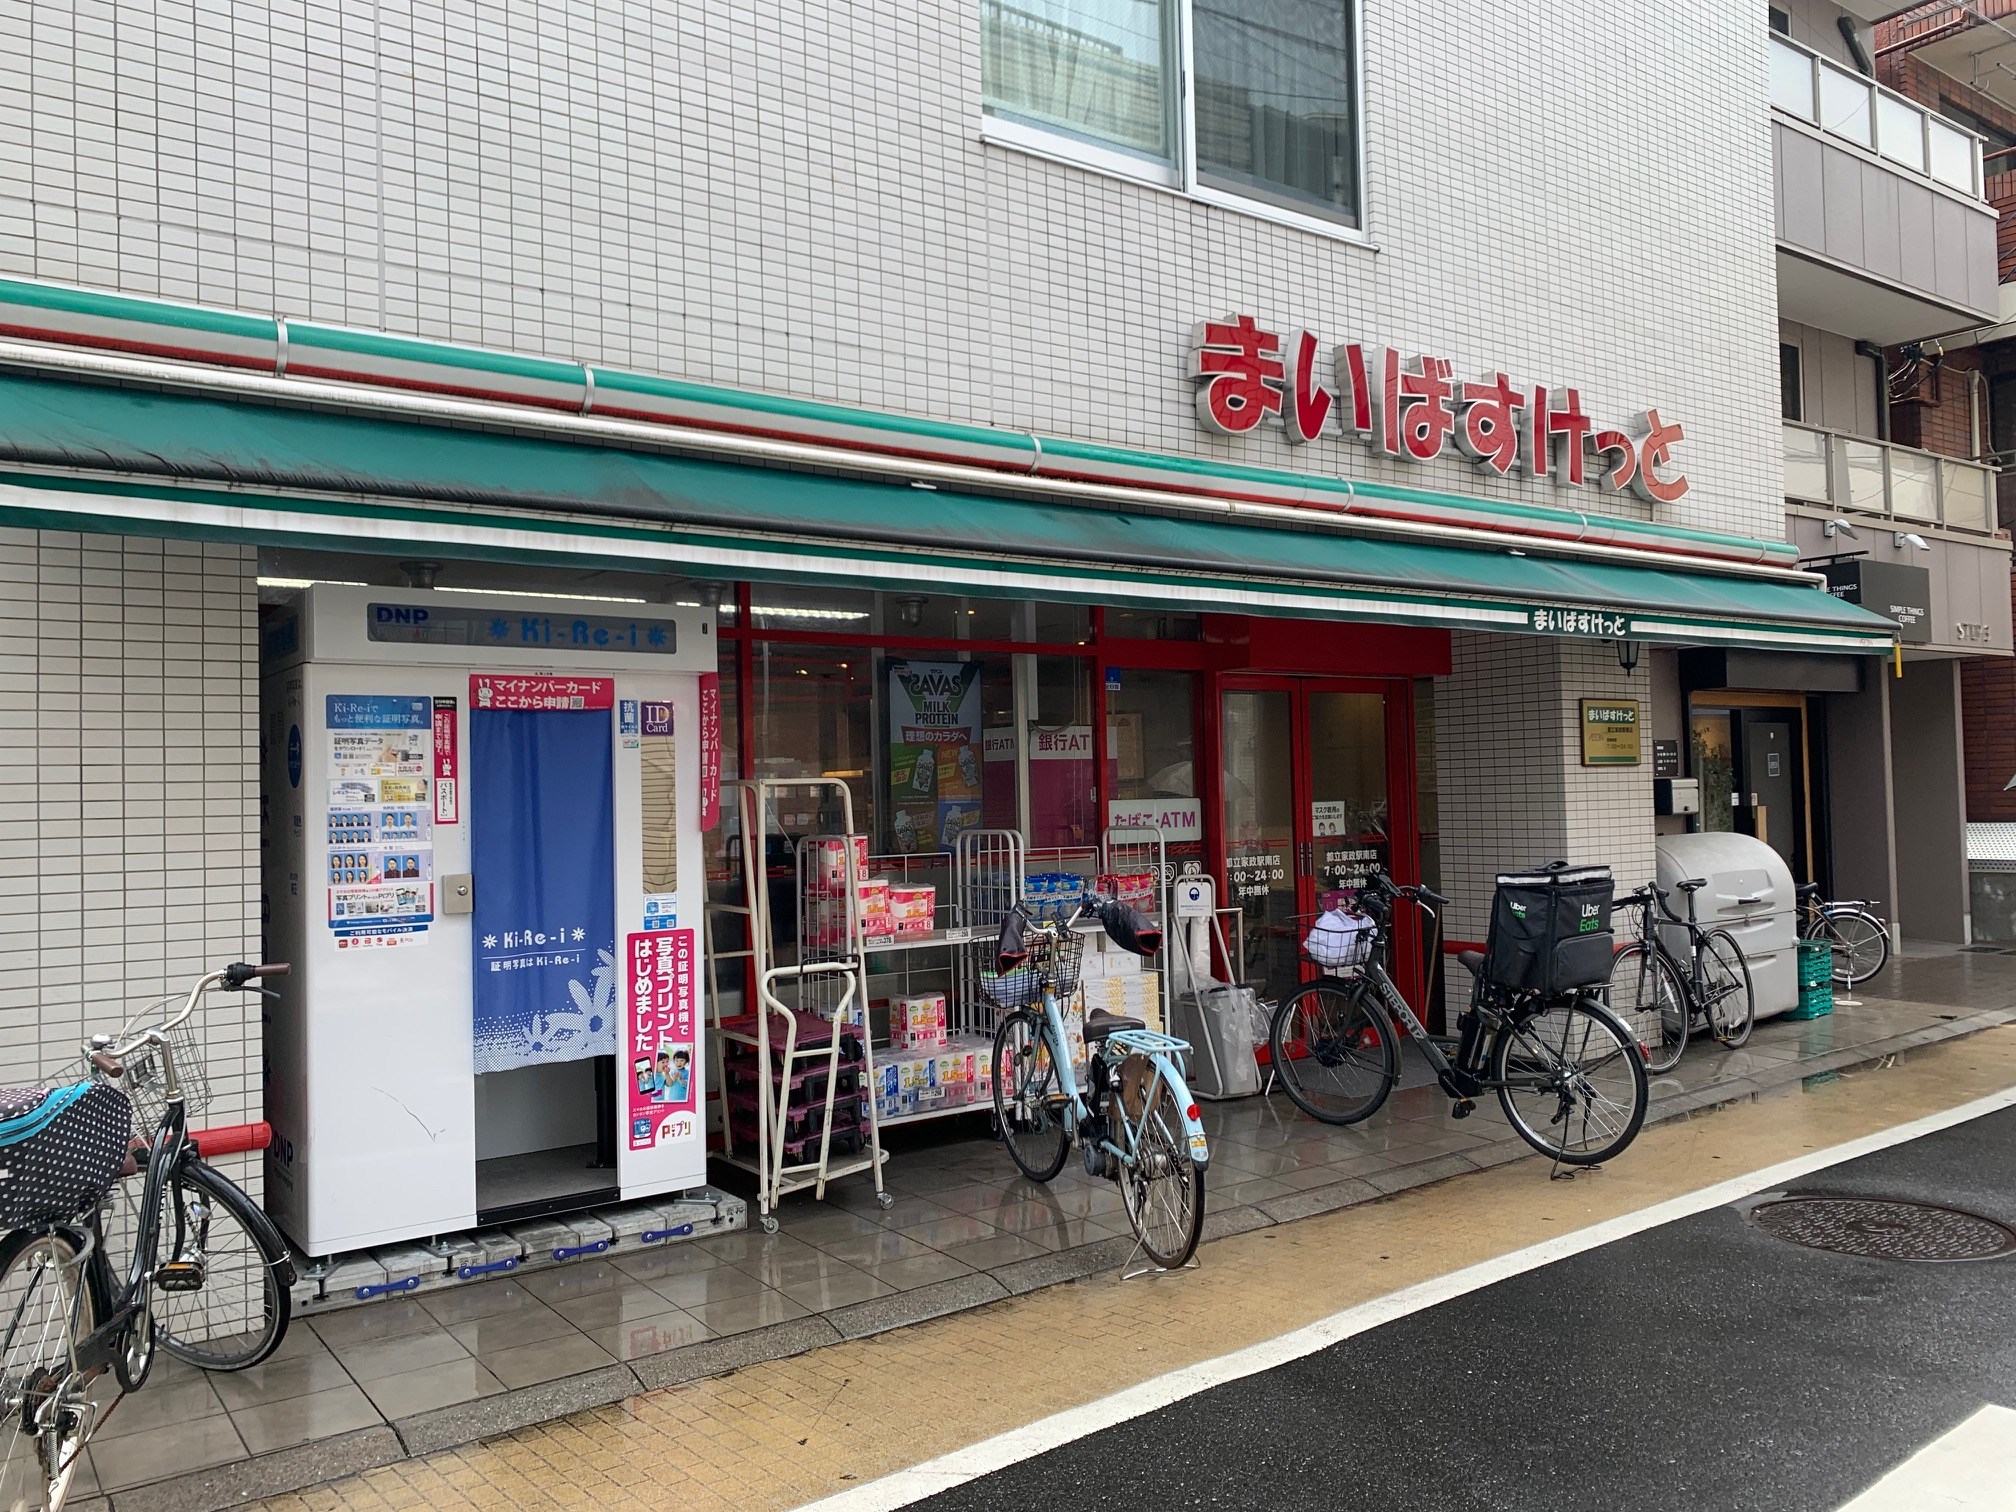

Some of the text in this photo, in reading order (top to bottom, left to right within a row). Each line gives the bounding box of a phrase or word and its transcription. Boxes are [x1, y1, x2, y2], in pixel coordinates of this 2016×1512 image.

[1190, 312, 1691, 504] まいばすけっと
[1832, 583, 1858, 592] THINGS
[376, 606, 429, 625] DNP
[1890, 604, 1925, 616] SIMPLE THINGS
[1533, 608, 1626, 636] まいばすけっと
[1898, 614, 1916, 624] COFFEE
[520, 617, 637, 647] Ki-Re-i
[493, 680, 602, 695] マイナンバーカード
[909, 674, 963, 697] SAVAS
[334, 702, 379, 713] Ki-Re-iで
[494, 694, 570, 709] ここから申請
[924, 701, 950, 713] MILK
[623, 701, 635, 723] 抗菌
[646, 705, 669, 724] ID
[915, 713, 959, 725] PROTEIN
[1588, 709, 1635, 722] まいばすけっと
[646, 723, 669, 733] Card
[701, 689, 709, 764] ここから申請
[334, 737, 384, 745] 証明写真データ
[905, 730, 968, 742] 理想のカラダへ
[709, 688, 718, 802] マイナンバーカード
[1315, 806, 1340, 814] マスク着用の
[1226, 854, 1281, 869] 都立家政駅南店
[1326, 850, 1378, 863] 都立家政駅南店
[862, 870, 867, 878] 8
[1238, 884, 1270, 897] 年中無休
[1338, 878, 1368, 890] 年中無休
[1510, 901, 1527, 912] Uber
[1582, 903, 1600, 918] Uber
[349, 926, 414, 936] ご利用可能なモバイル決済
[926, 920, 931, 928] 8
[1580, 918, 1600, 932] Eats
[504, 927, 565, 949] Ki-Re-i
[490, 953, 580, 972] 証明写真は Ki-Re-i
[678, 935, 689, 1036] この証明写真機で
[634, 938, 653, 1053] はじめました
[655, 937, 675, 1050] 写真プリント
[940, 1030, 944, 1038] 8
[274, 1130, 293, 1168] DNP
